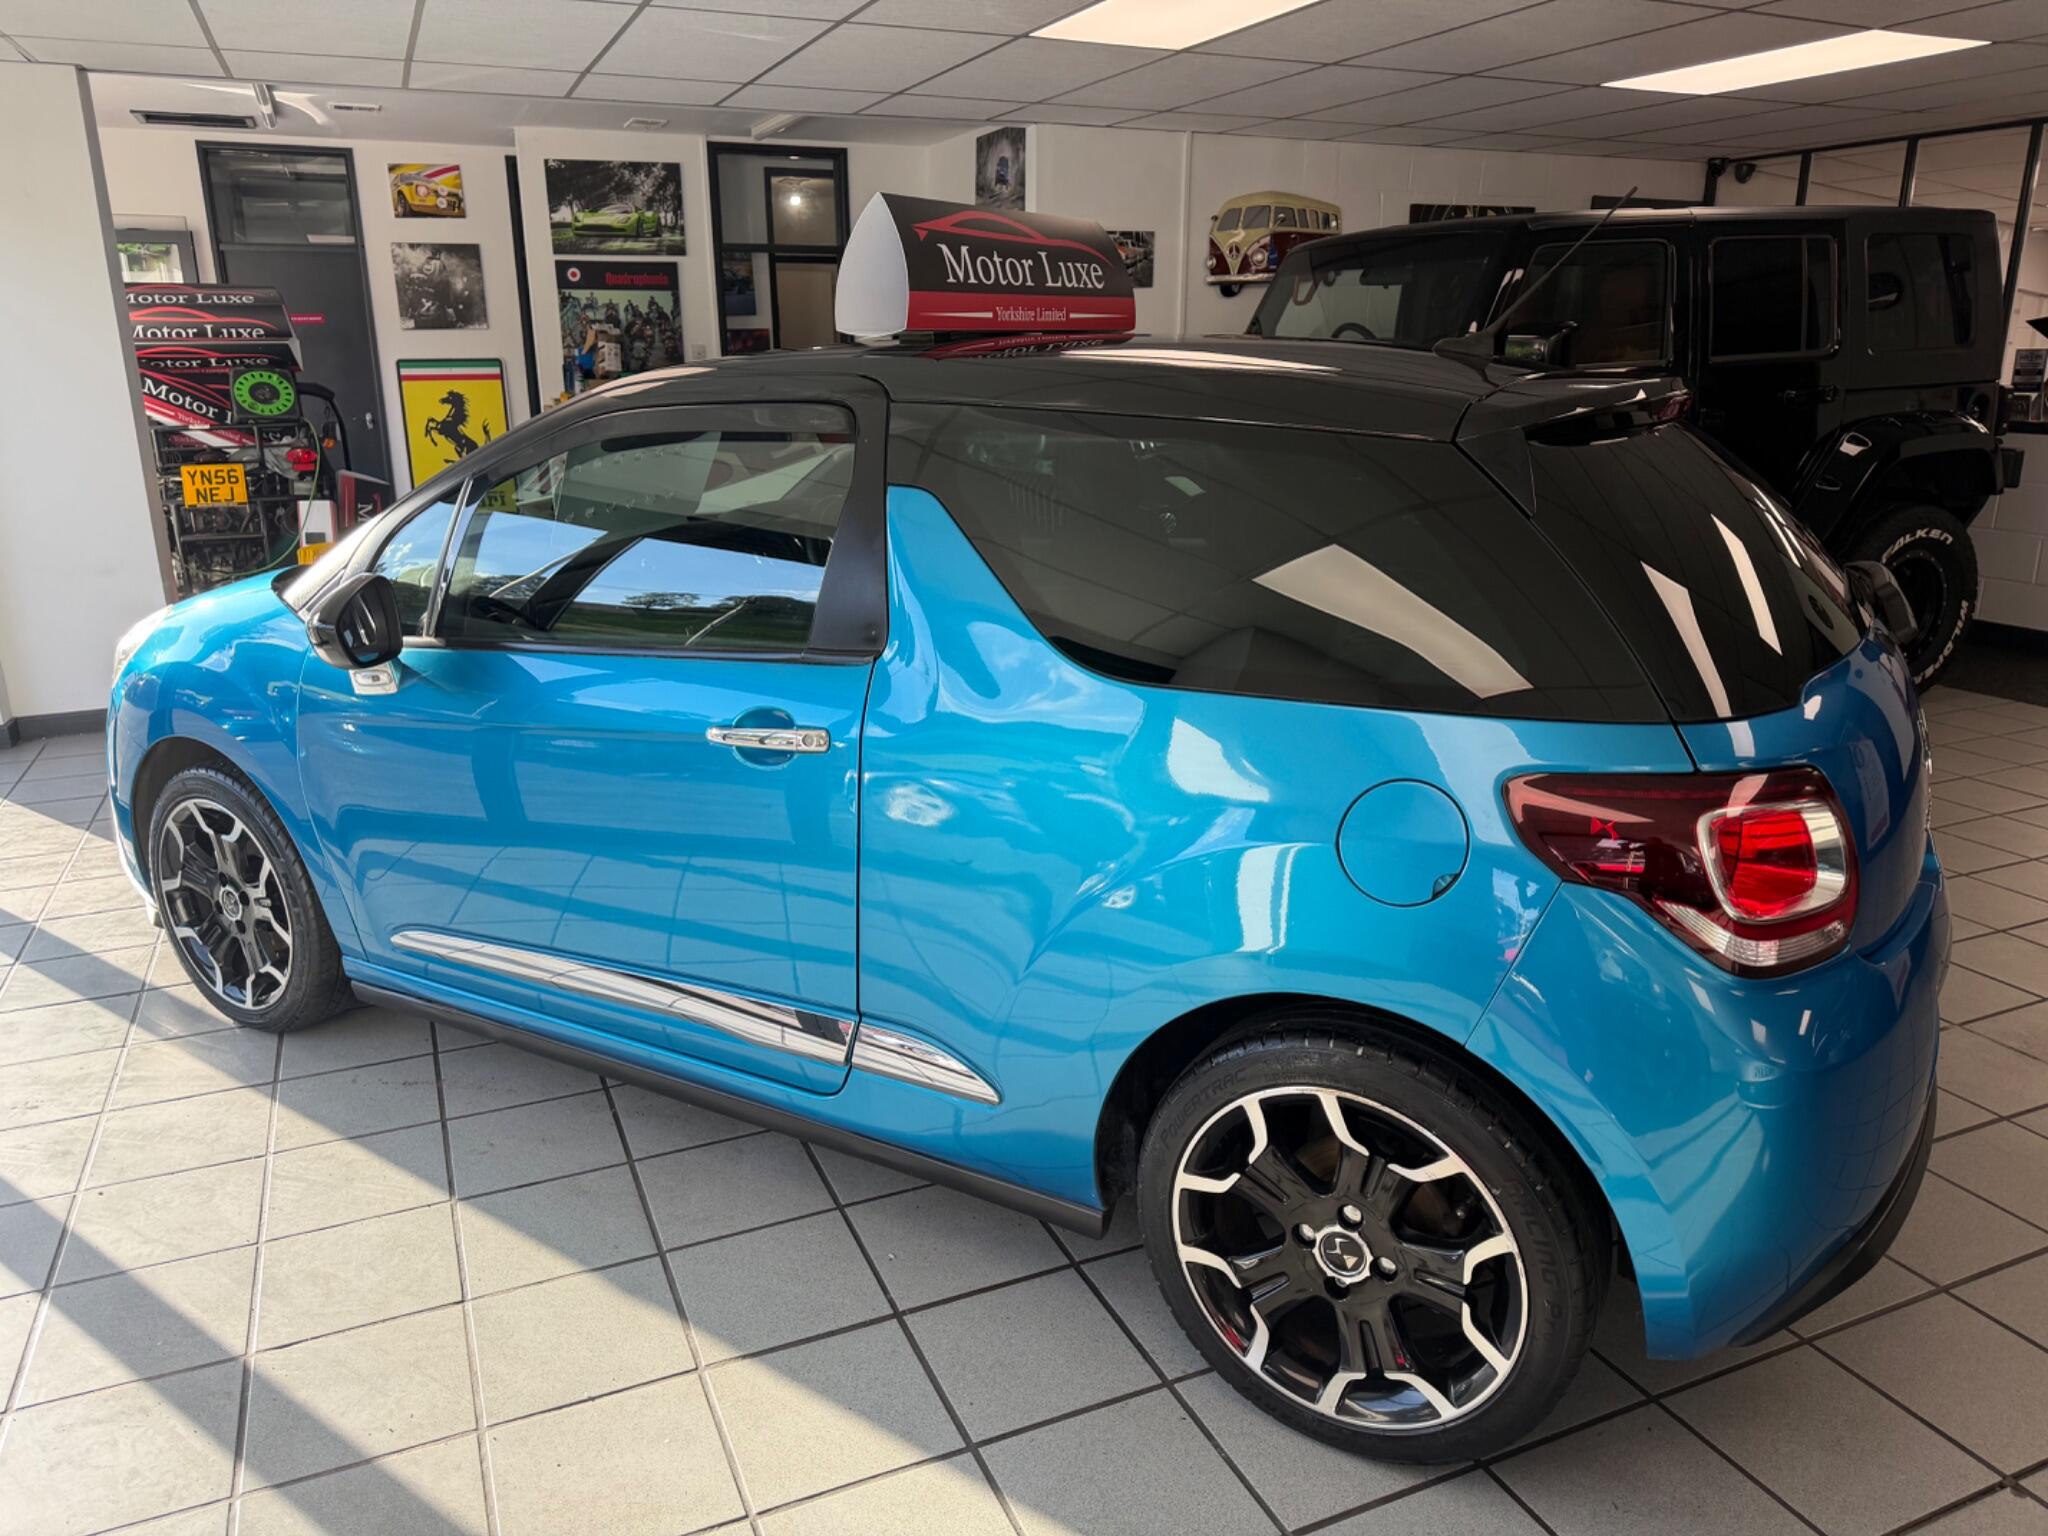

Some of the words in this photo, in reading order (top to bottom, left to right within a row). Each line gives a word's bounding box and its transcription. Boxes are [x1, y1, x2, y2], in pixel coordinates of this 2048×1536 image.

[936, 243, 1034, 287] Motor
[1037, 250, 1105, 290] Luxe
[197, 293, 255, 304] Luxe
[996, 306, 1035, 322] Yorkshire
[1036, 307, 1067, 321] Limited
[204, 323, 266, 338] Luxe
[143, 377, 218, 418] Motor
[186, 468, 240, 485] YN56
[195, 487, 236, 503] NEJ
[1159, 1066, 1248, 1150] POWERTRAC
